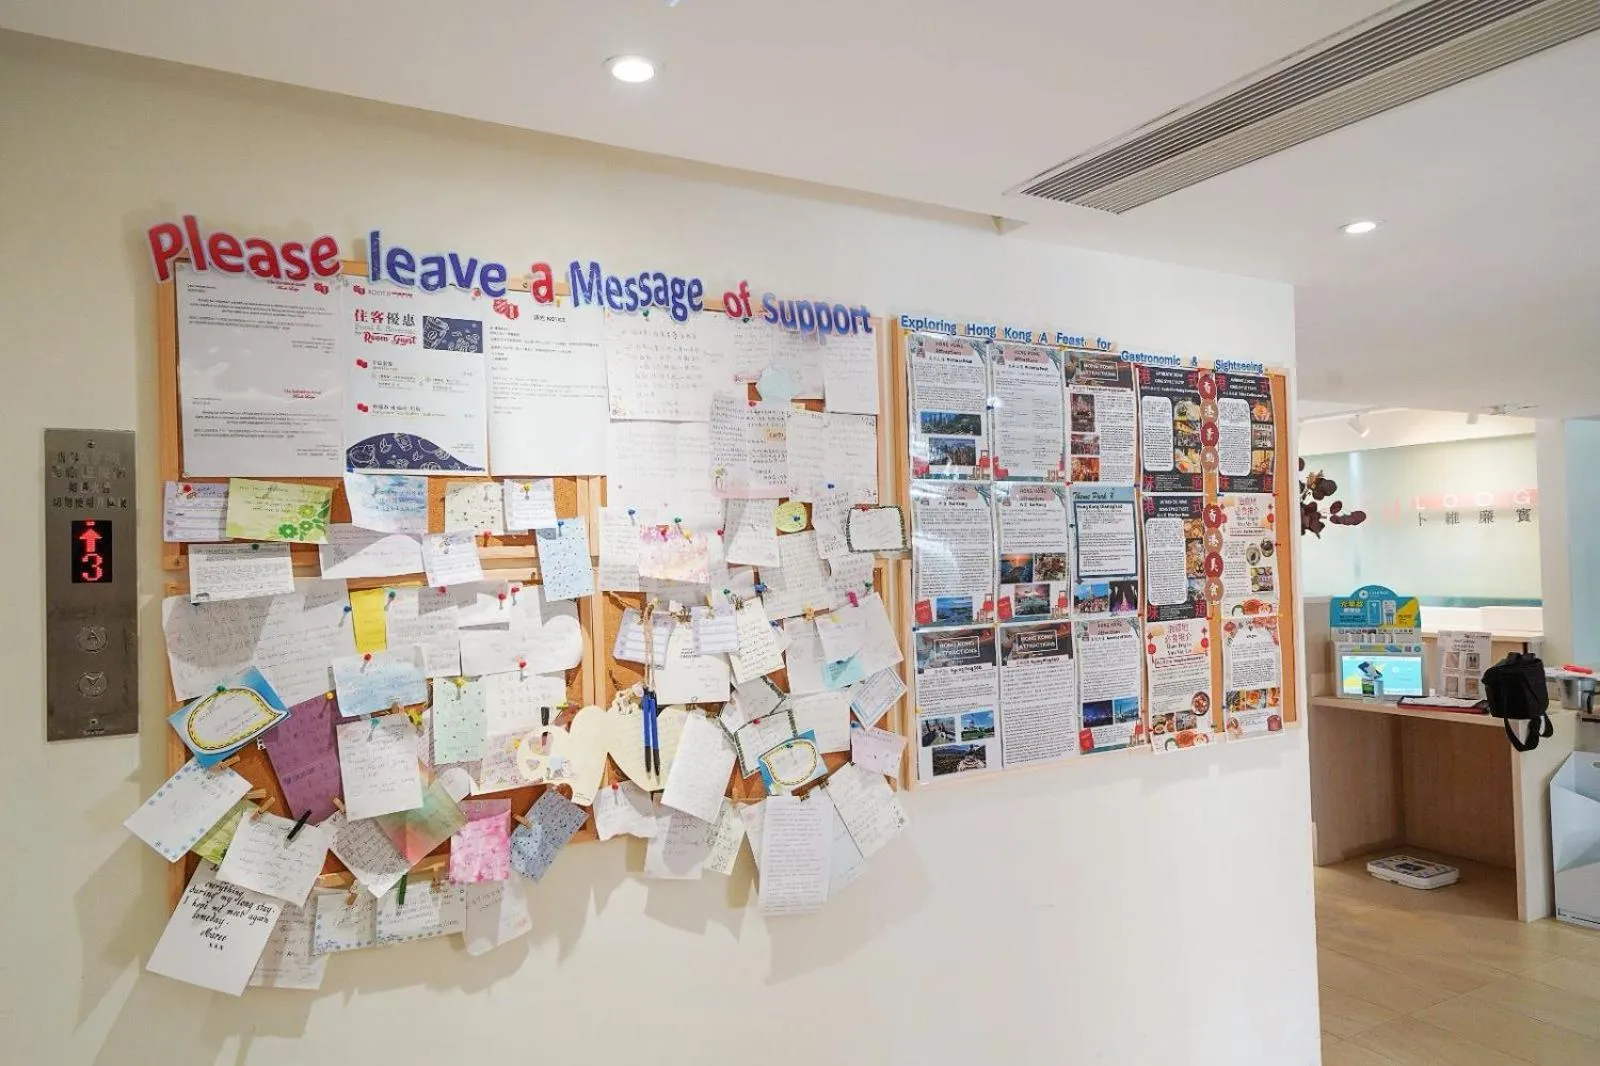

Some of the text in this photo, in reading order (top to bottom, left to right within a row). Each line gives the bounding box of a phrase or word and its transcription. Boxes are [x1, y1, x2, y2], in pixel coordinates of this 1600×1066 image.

[147, 214, 342, 282] Please
[369, 230, 508, 298] leave
[531, 262, 554, 304] a
[569, 260, 704, 321] Message
[723, 281, 753, 318] of
[354, 309, 416, 326] 住客優惠
[363, 331, 388, 343] Room
[901, 315, 1264, 374] Exploring Hong Kong A Feast for Gastronomic & Sightseeing
[1416, 489, 1531, 510] LODG
[82, 553, 102, 581] 3
[183, 895, 189, 905] I
